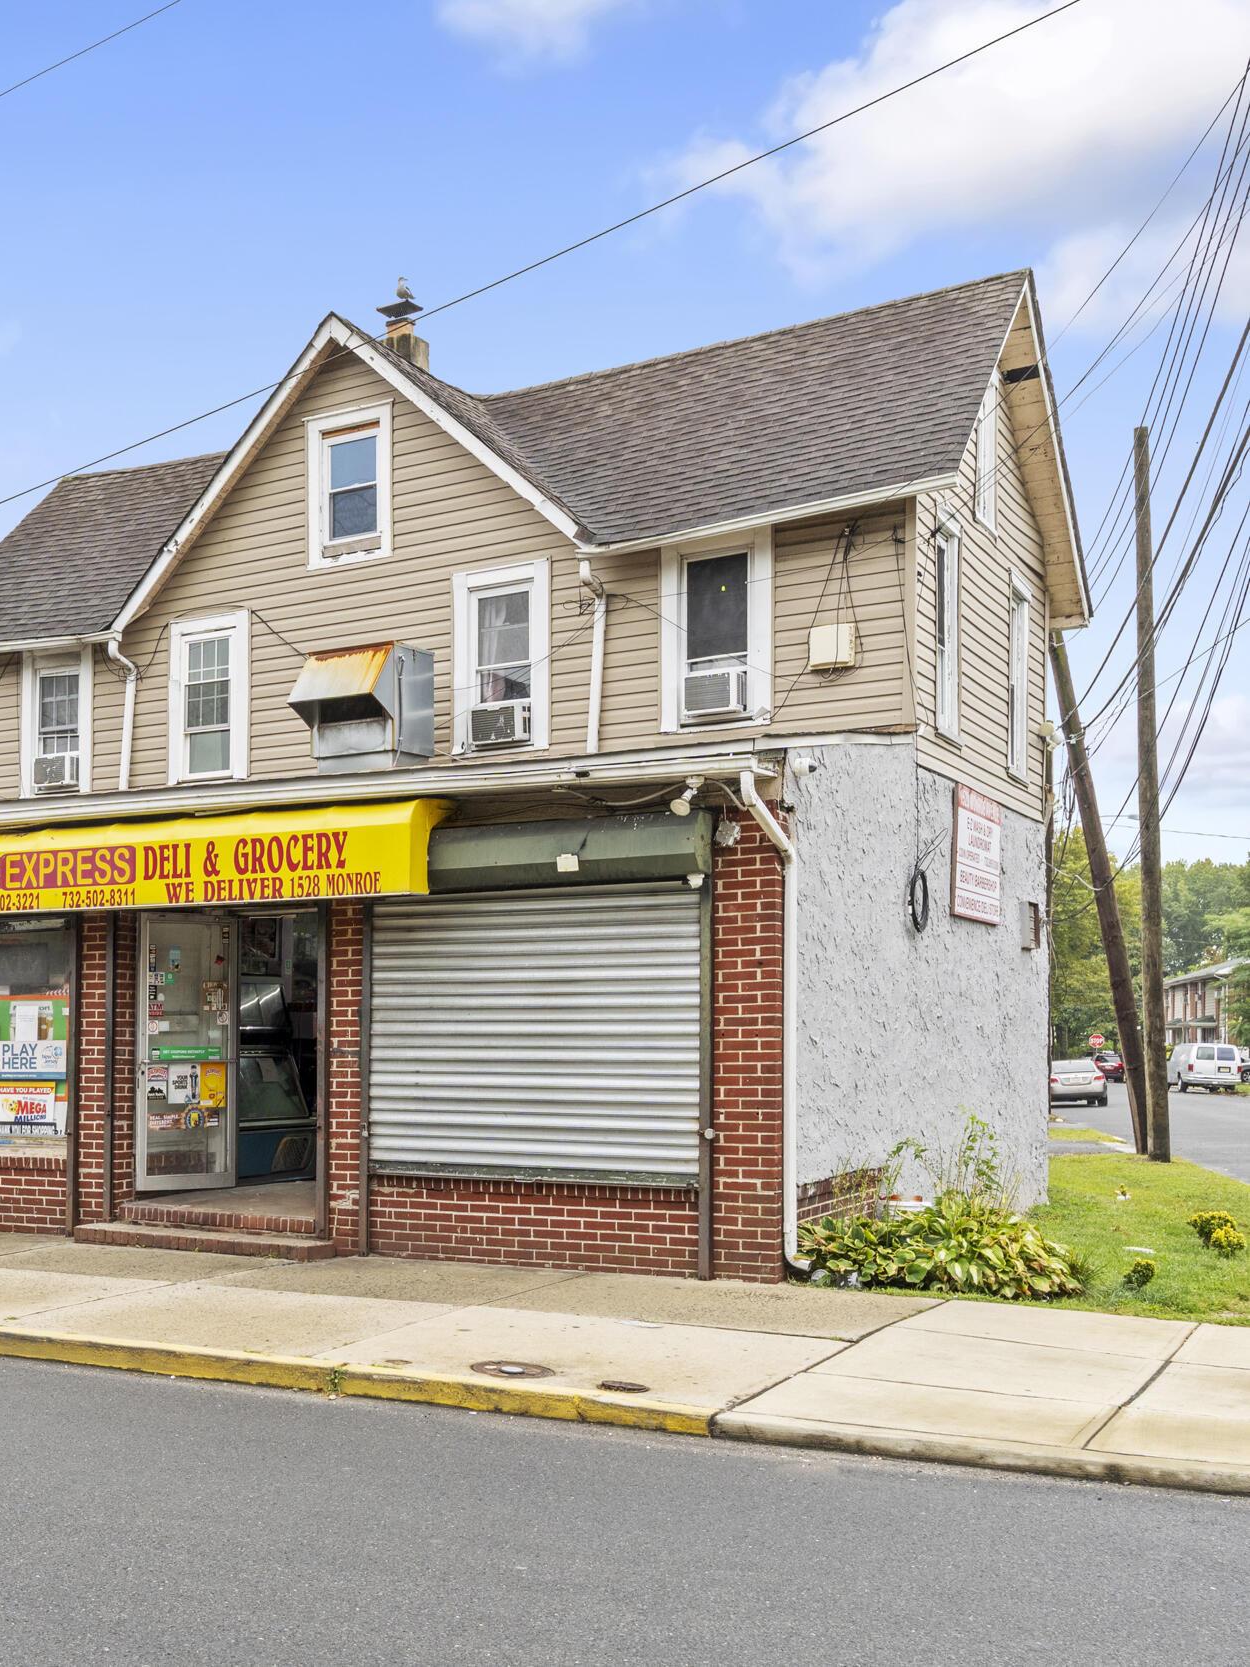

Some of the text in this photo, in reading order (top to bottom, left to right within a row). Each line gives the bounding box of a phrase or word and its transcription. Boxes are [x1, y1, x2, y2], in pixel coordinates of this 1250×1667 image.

[143, 831, 348, 881] DELI & GROCERY
[5, 847, 131, 889] EXPRESS
[165, 871, 382, 904] WE DELIVER 1528 MONROE
[62, 888, 136, 909] 732-502-8311
[2, 1043, 38, 1056] PLAY
[2, 1057, 38, 1069] HERE
[16, 1100, 46, 1115] MEGA
[14, 1114, 47, 1123] MILLIONS
